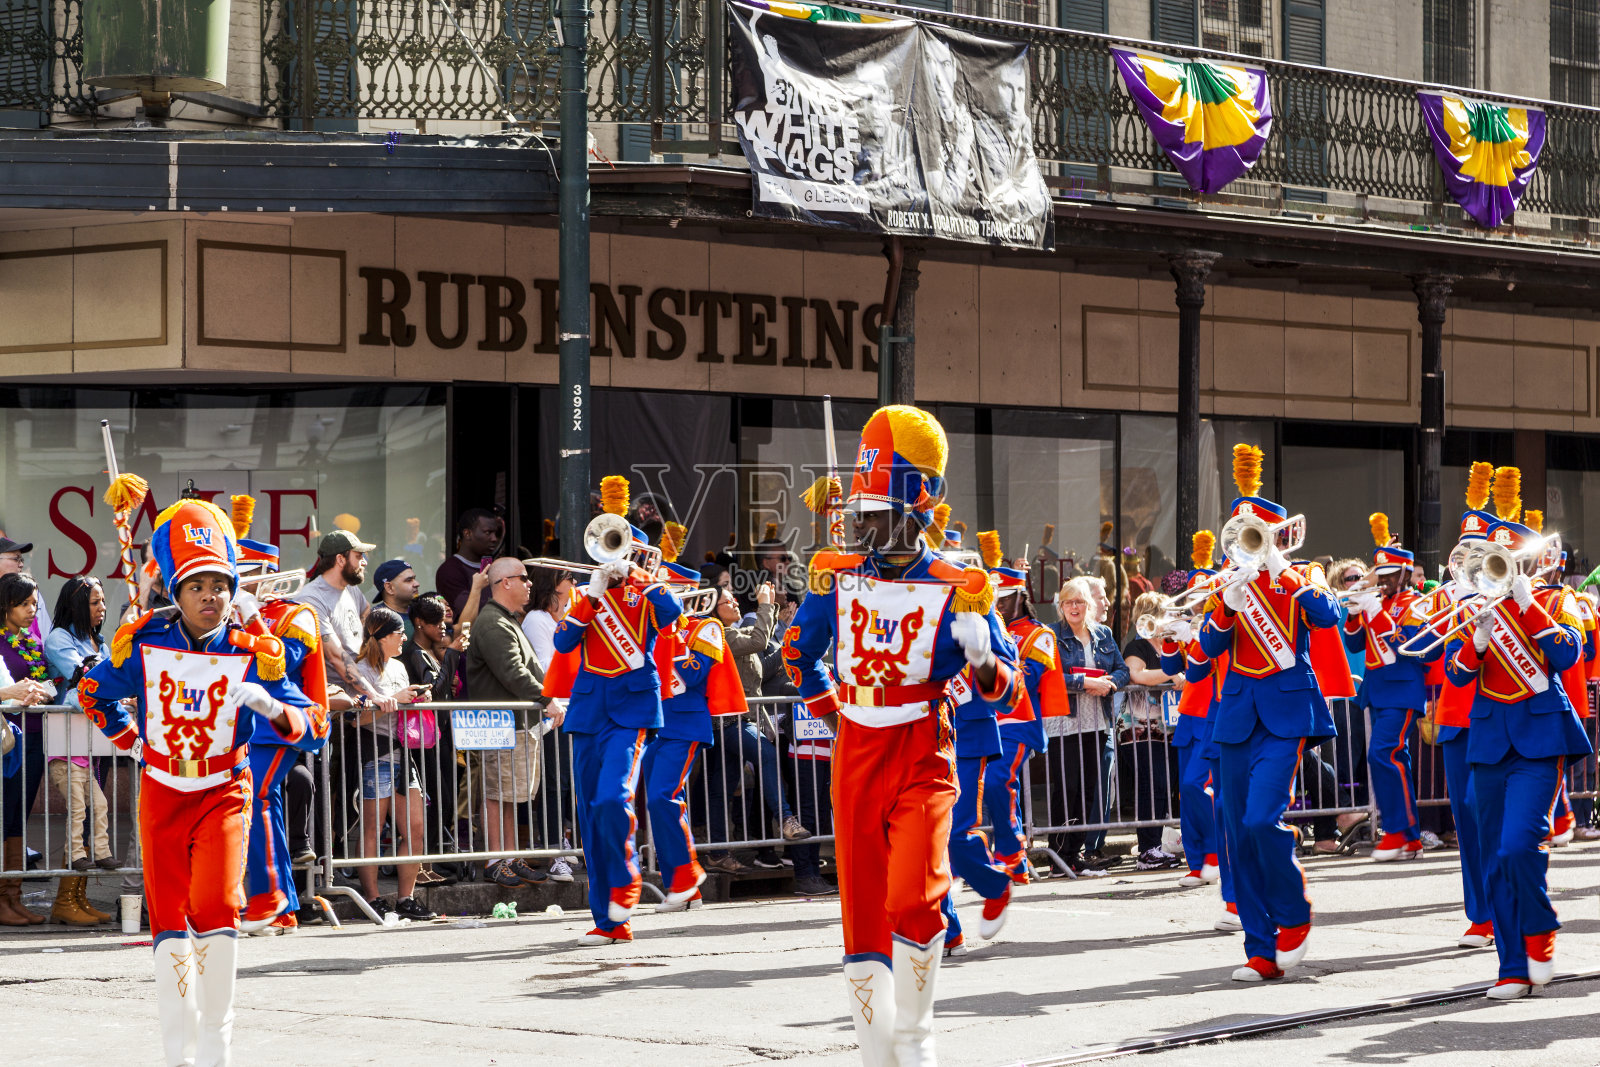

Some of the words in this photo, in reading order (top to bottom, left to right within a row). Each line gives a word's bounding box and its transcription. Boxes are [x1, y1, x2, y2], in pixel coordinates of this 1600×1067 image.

[735, 110, 861, 153] WHITE
[887, 209, 920, 229] ROBERT
[604, 614, 635, 656] WALKER
[1250, 608, 1283, 652] WALKER
[1500, 632, 1537, 678] WALKER
